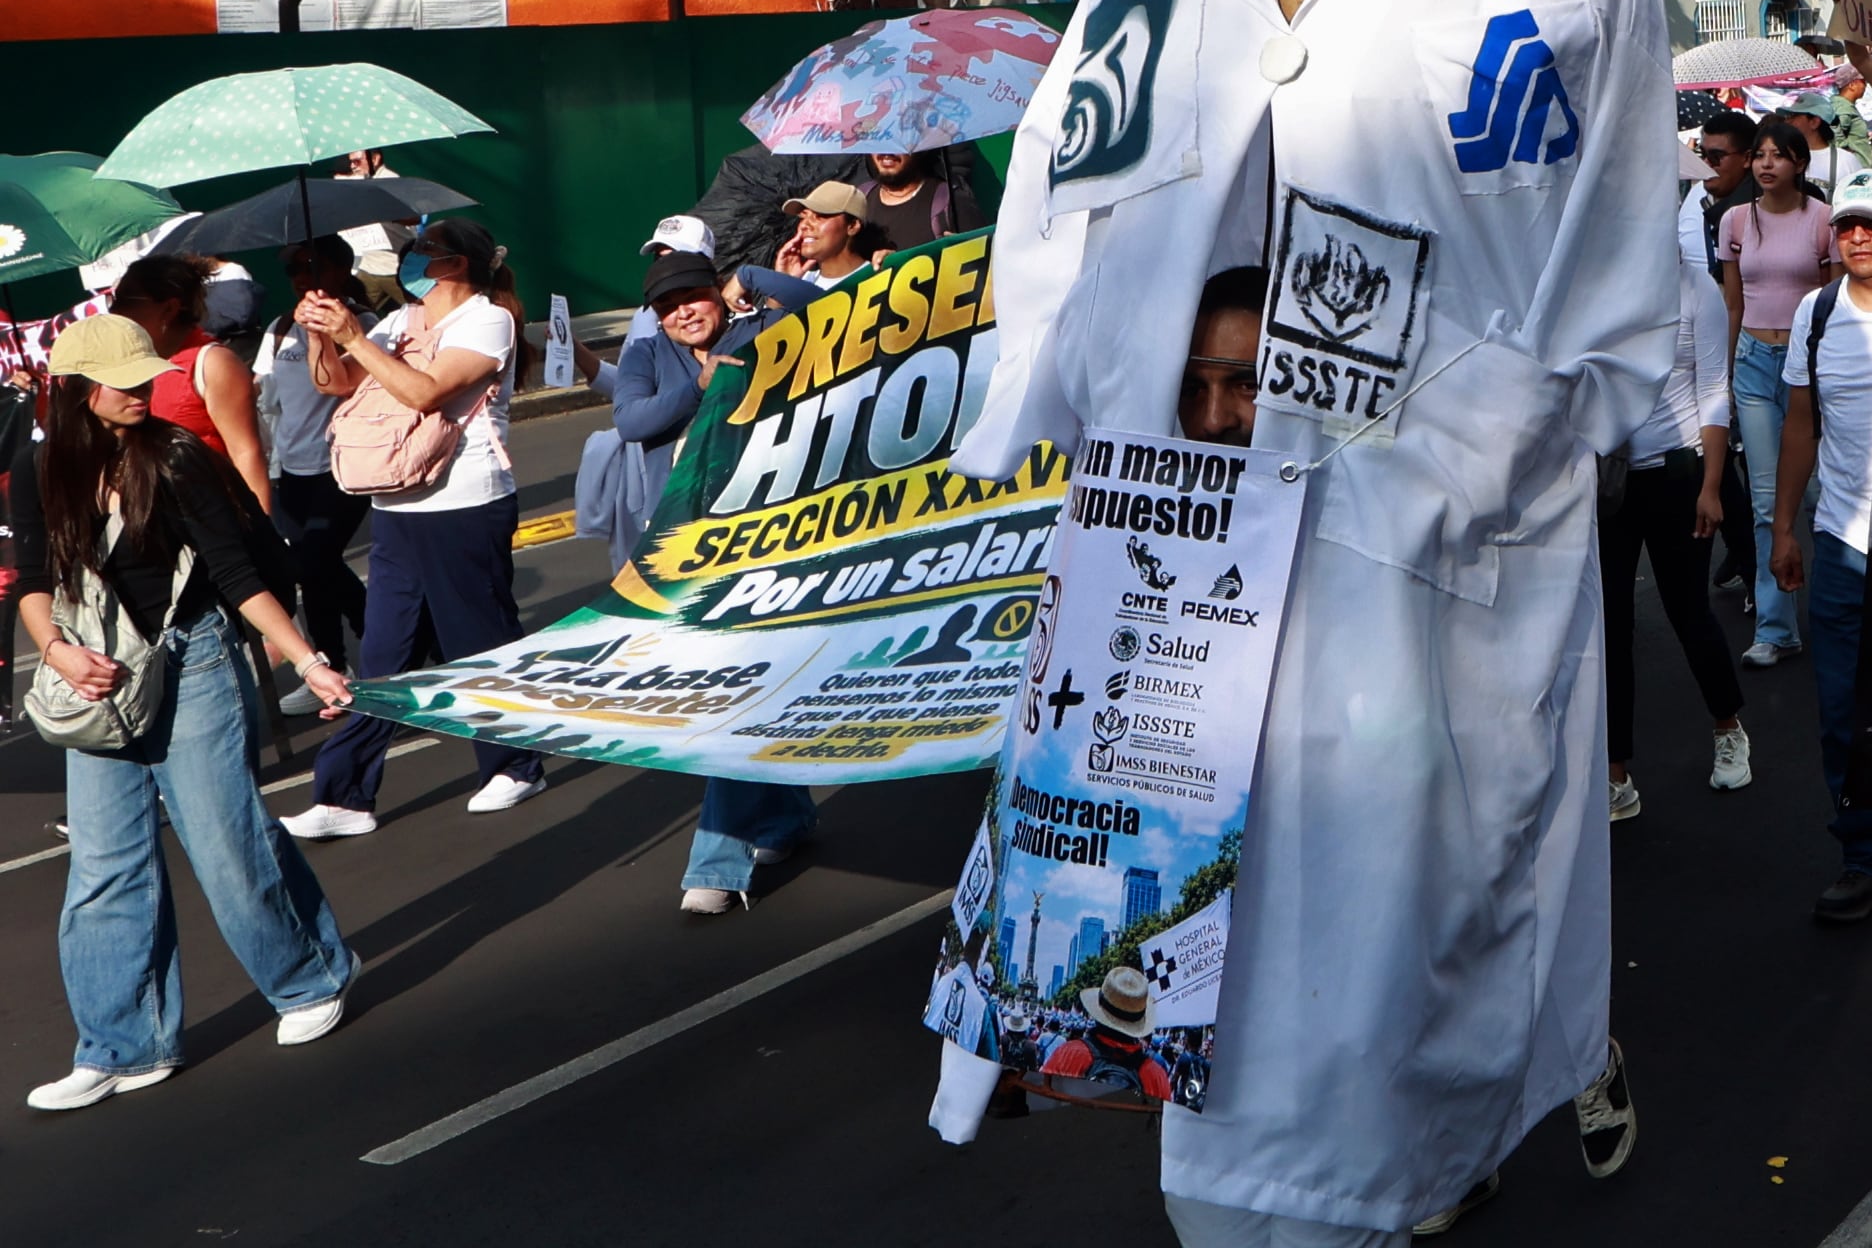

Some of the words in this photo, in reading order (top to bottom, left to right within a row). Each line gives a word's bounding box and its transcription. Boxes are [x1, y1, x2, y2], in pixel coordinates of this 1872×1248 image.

[1118, 443, 1247, 495] mayor
[678, 479, 908, 573] SECCIÓN
[702, 570, 832, 622] Por
[832, 557, 895, 600] un
[1121, 592, 1169, 612] CNTE
[1180, 601, 1260, 627] PEMEX
[1146, 633, 1211, 663] Salud
[618, 661, 771, 691] base
[819, 672, 912, 692] Quieren
[912, 669, 961, 688] que
[1133, 675, 1204, 700] BIRMEX
[784, 691, 911, 710] pensemos
[908, 687, 937, 702] lo
[935, 683, 1018, 701] mismo
[768, 711, 798, 725] y
[793, 710, 843, 727] que
[841, 706, 875, 721] el
[867, 707, 919, 722] que
[911, 702, 1000, 722] piense
[1132, 713, 1196, 738] ISSSTE
[731, 723, 827, 738] distinto
[824, 725, 903, 744] tenga
[897, 718, 989, 738] miedo
[1116, 754, 1147, 771] IMSS
[1149, 759, 1217, 784] BIENESTAR
[1087, 773, 1131, 788] SERVICIOS
[1133, 778, 1175, 795] PÚBLICOS
[1177, 787, 1188, 798] DE
[1189, 789, 1216, 803] SALUD
[1008, 775, 1141, 836] Democracia
[1011, 816, 1110, 868] sindical!
[1175, 920, 1219, 951] HOSPITAL
[1178, 935, 1223, 965] GENERAL
[1191, 948, 1225, 976] MÉXICO
